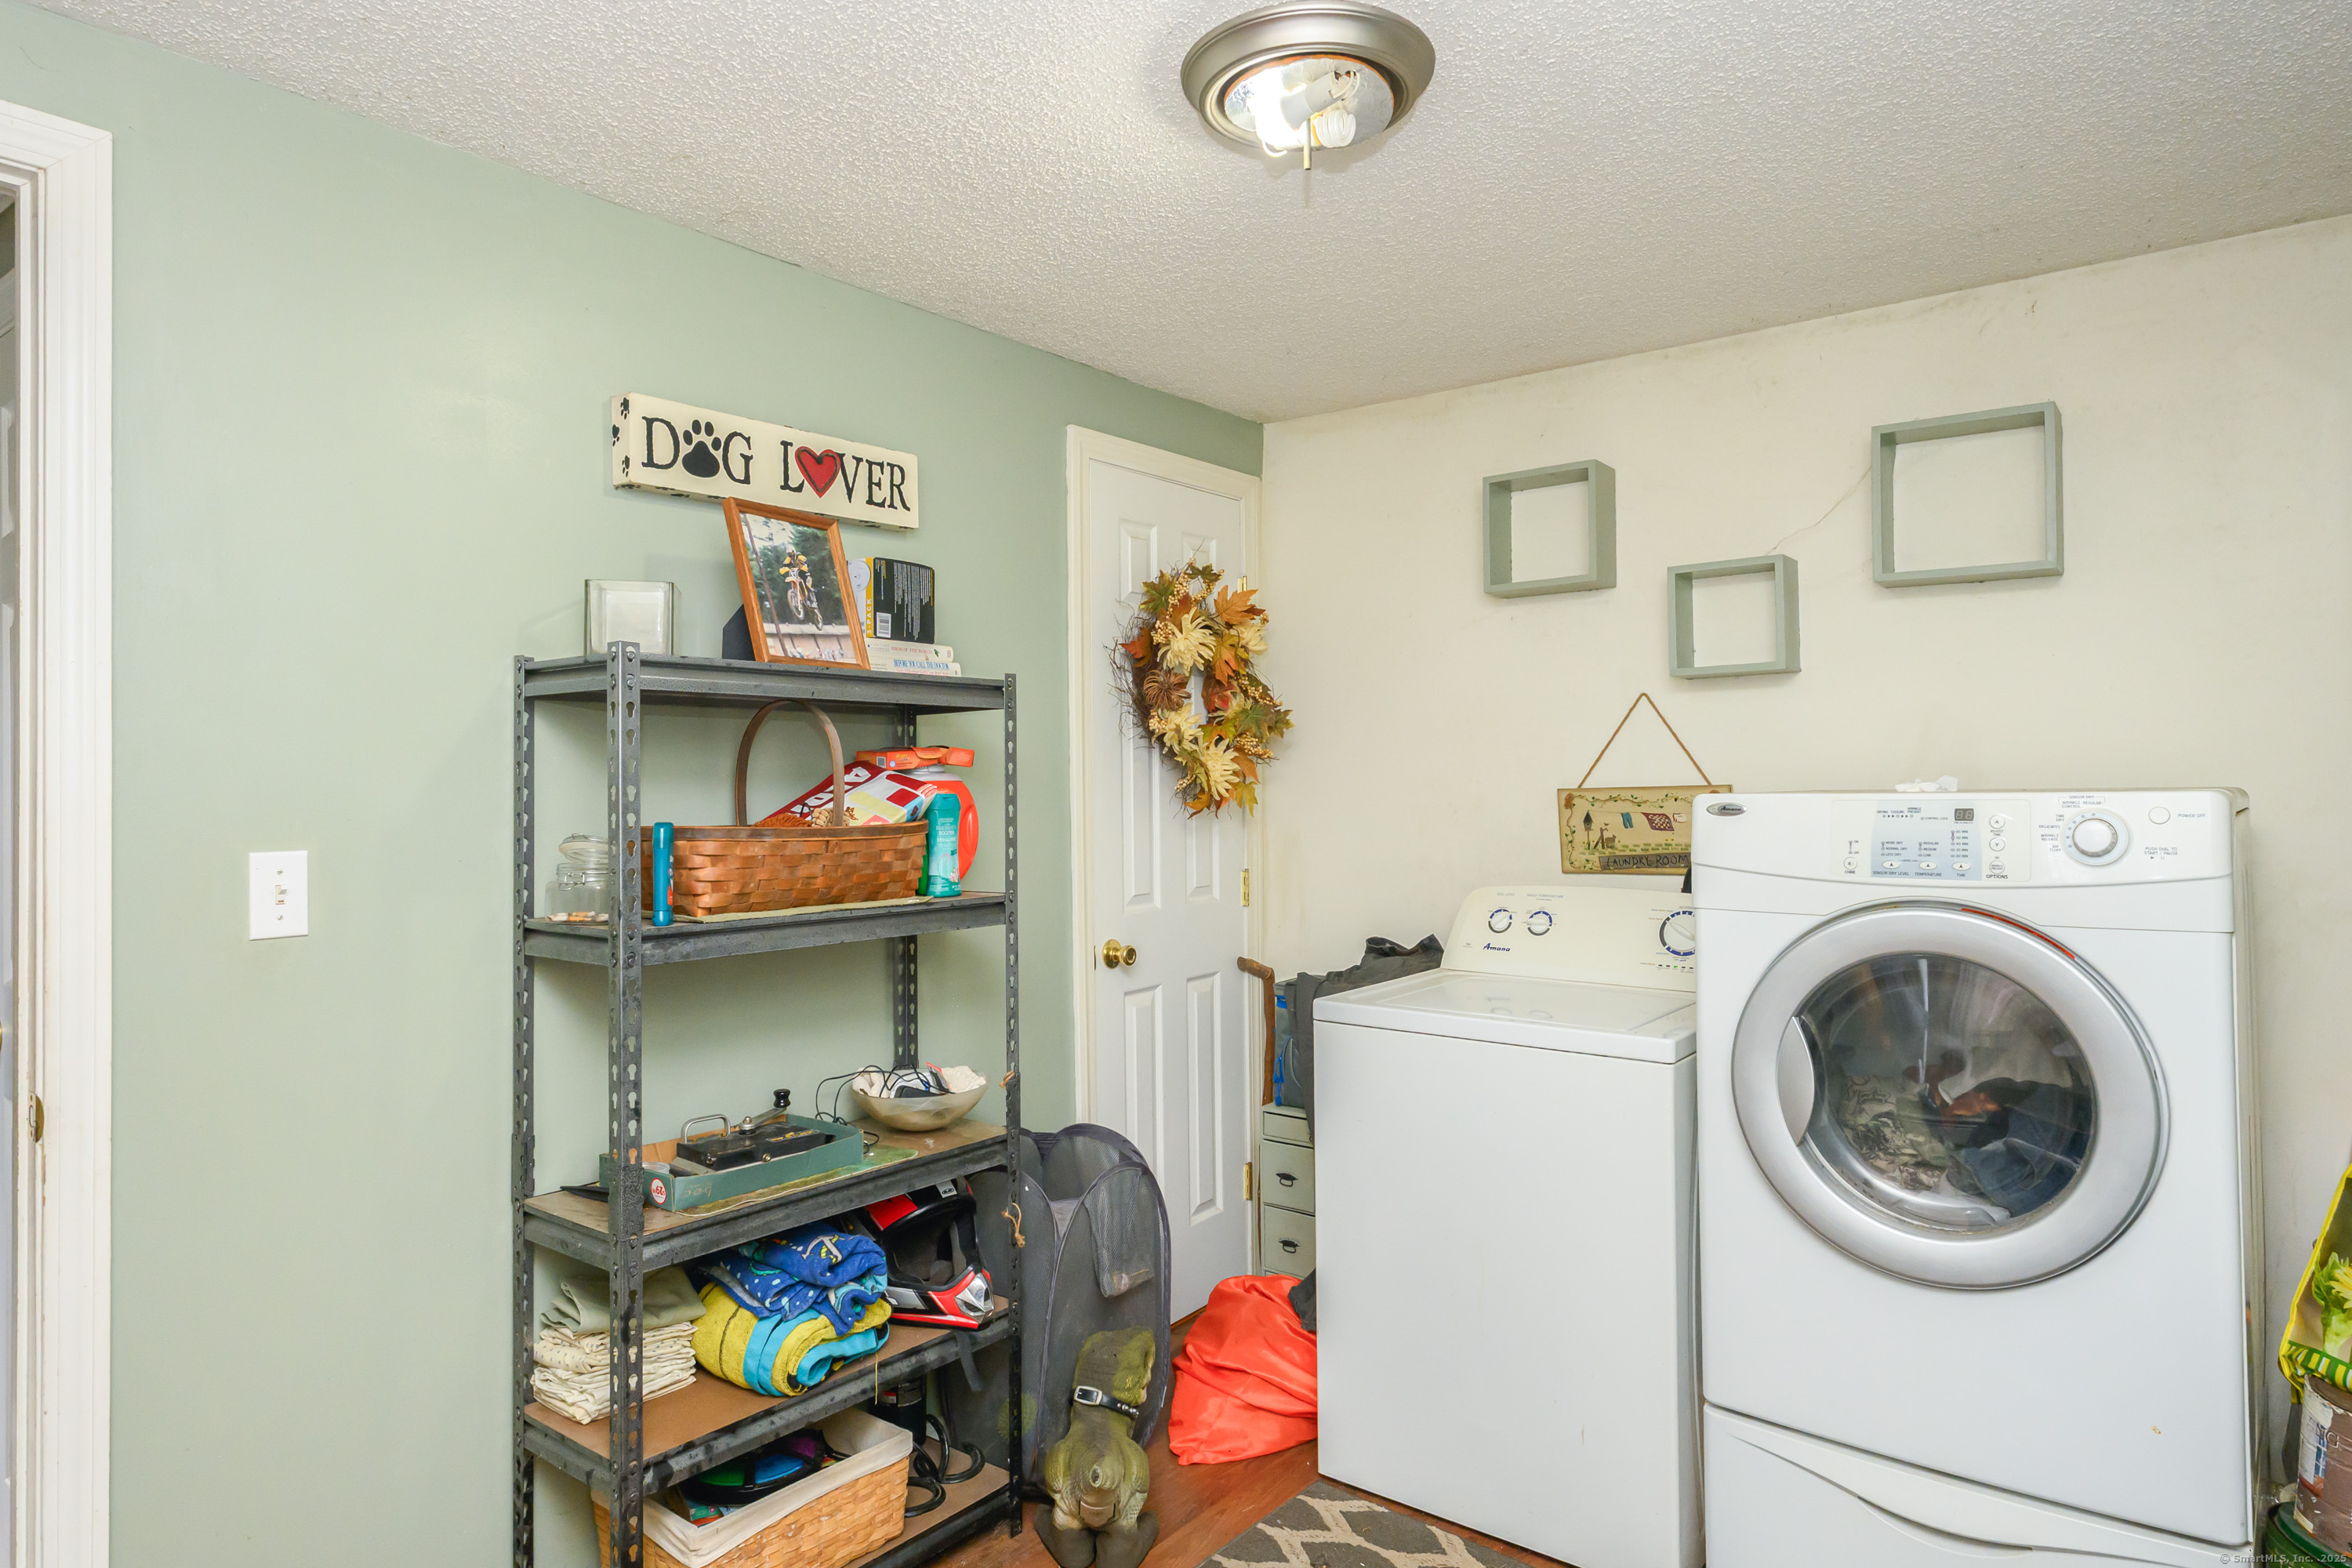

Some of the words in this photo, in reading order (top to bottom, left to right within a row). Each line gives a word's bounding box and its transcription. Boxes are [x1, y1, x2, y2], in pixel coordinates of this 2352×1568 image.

[1607, 855, 1652, 866] LAUNDRY
[1656, 855, 1690, 866] ROOM
[1483, 943, 1511, 951] Amana
